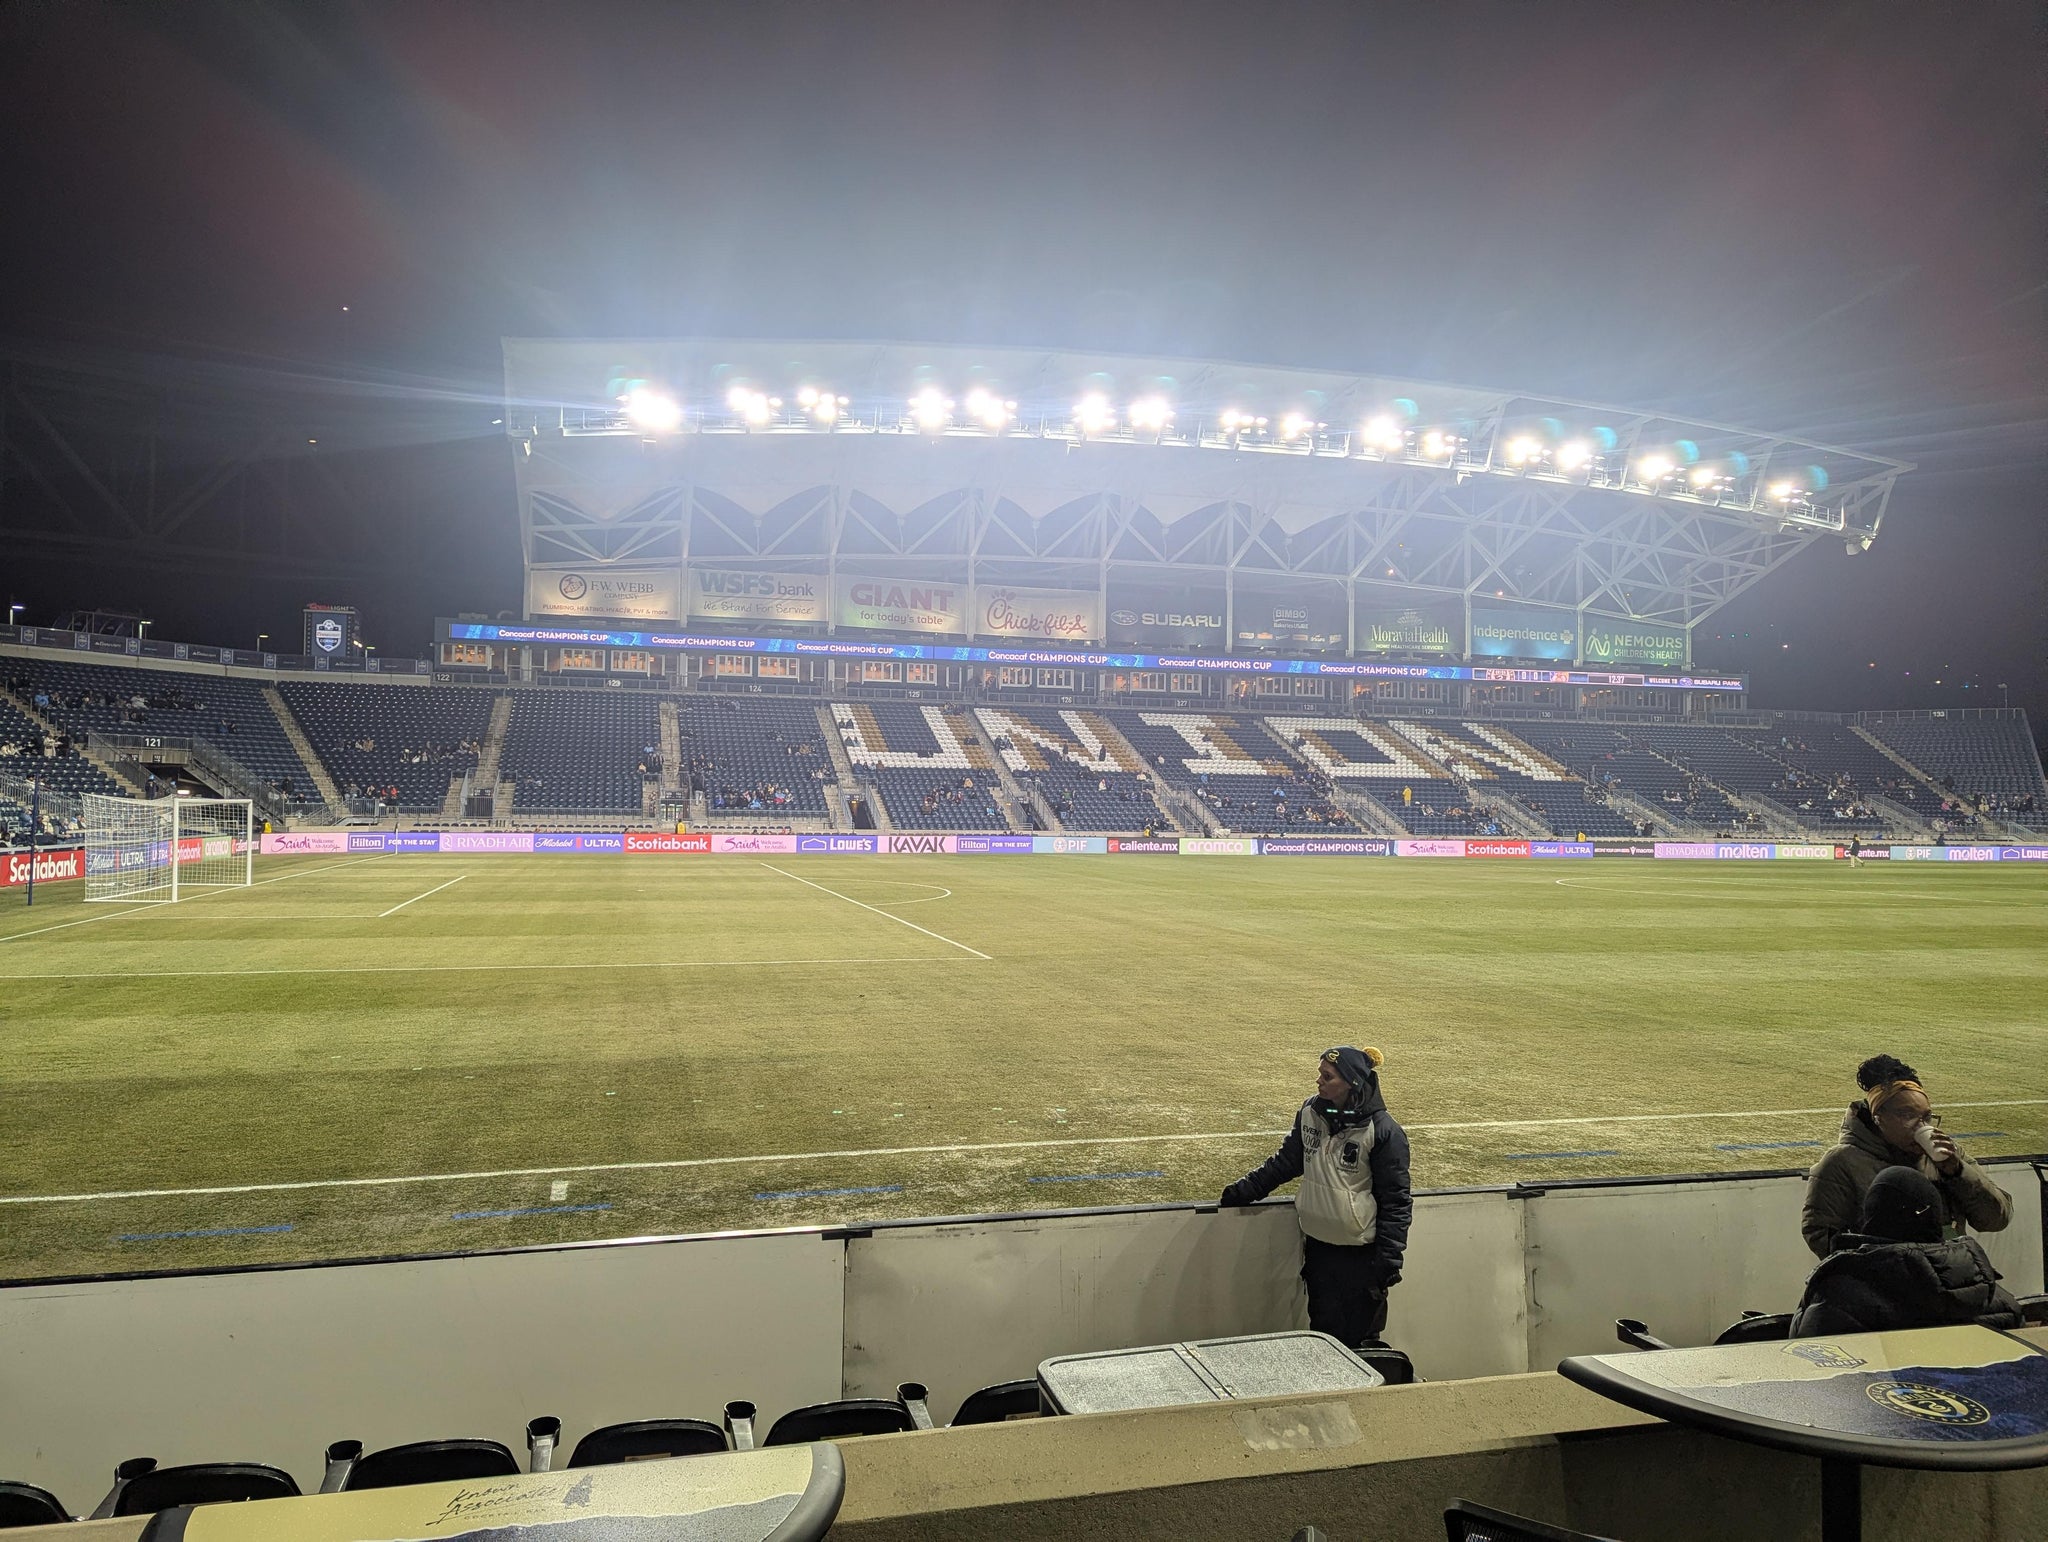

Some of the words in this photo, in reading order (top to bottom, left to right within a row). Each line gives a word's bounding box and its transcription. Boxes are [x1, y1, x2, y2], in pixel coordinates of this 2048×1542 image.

[590, 581, 612, 591] F.W.
[617, 582, 654, 594] WEBB
[698, 572, 775, 595] WSFS
[778, 581, 814, 597] bank
[850, 583, 954, 612] GIANT
[703, 601, 718, 610] We
[720, 601, 752, 612] Stand
[756, 603, 773, 612] For
[776, 602, 814, 615] Service
[1275, 609, 1307, 619] BIMBO
[860, 610, 875, 620] for
[877, 612, 915, 625] today's
[917, 614, 943, 625] table
[987, 598, 1088, 635] Chick-fil-A
[1141, 613, 1222, 628] SUBARU
[498, 629, 535, 639] Concacaf
[536, 630, 589, 641] CHAMPIONS
[590, 633, 609, 642] CUP
[1473, 624, 1558, 642] Independence
[652, 636, 687, 645] Concacaf
[687, 637, 737, 647] CHAMPIONS
[738, 639, 756, 648] CUP
[1614, 634, 1683, 648] NEMOURS
[796, 643, 829, 652] Concacaf
[829, 644, 877, 655] CHAMPIONS
[878, 647, 894, 655] CUP
[1614, 648, 1655, 659] CHILDREN'S
[1656, 650, 1683, 660] HEALTH
[988, 651, 1028, 661] Concacaf
[1029, 653, 1087, 664] CHAMPIONS
[1088, 655, 1108, 664] CUP
[1158, 658, 1197, 667] Concacaf
[1197, 659, 1251, 669] CHAMPIONS
[1253, 661, 1272, 670] CUP
[1320, 664, 1356, 674] Concacaf
[1357, 665, 1408, 676] CHAMPIONS
[1410, 667, 1428, 676] CUP
[1061, 696, 1072, 704] 126
[145, 738, 161, 747] 121
[831, 703, 1575, 782] UNION
[271, 835, 311, 852] Saudi
[351, 836, 382, 848] Hilton
[457, 836, 506, 848] RIYADH
[508, 836, 531, 848] AIR
[534, 836, 574, 848] Michelob
[584, 836, 621, 847] ULTRA
[627, 837, 708, 851] Scotiabank
[721, 837, 760, 851] Saudi
[829, 838, 873, 851] LOWE'S
[888, 836, 946, 852] KAVAK
[960, 839, 987, 850] Hilton
[1068, 840, 1088, 850] PIF
[1119, 840, 1178, 851] caliente.mx
[1187, 840, 1244, 853] aramco
[1265, 842, 1306, 852] Concacaf
[1307, 843, 1363, 852] CHAMPIONS
[1366, 843, 1385, 852] CUP
[1467, 843, 1528, 855] Scotiabank
[1565, 845, 1591, 854] ULTRA
[1665, 845, 1698, 855] RIYADH
[1699, 845, 1715, 855] AIR
[1719, 844, 1769, 858] molten
[1782, 846, 1828, 857] aramco
[1844, 849, 1889, 858] cente.mx
[1916, 848, 1932, 858] PIF
[1949, 847, 1993, 860] molten
